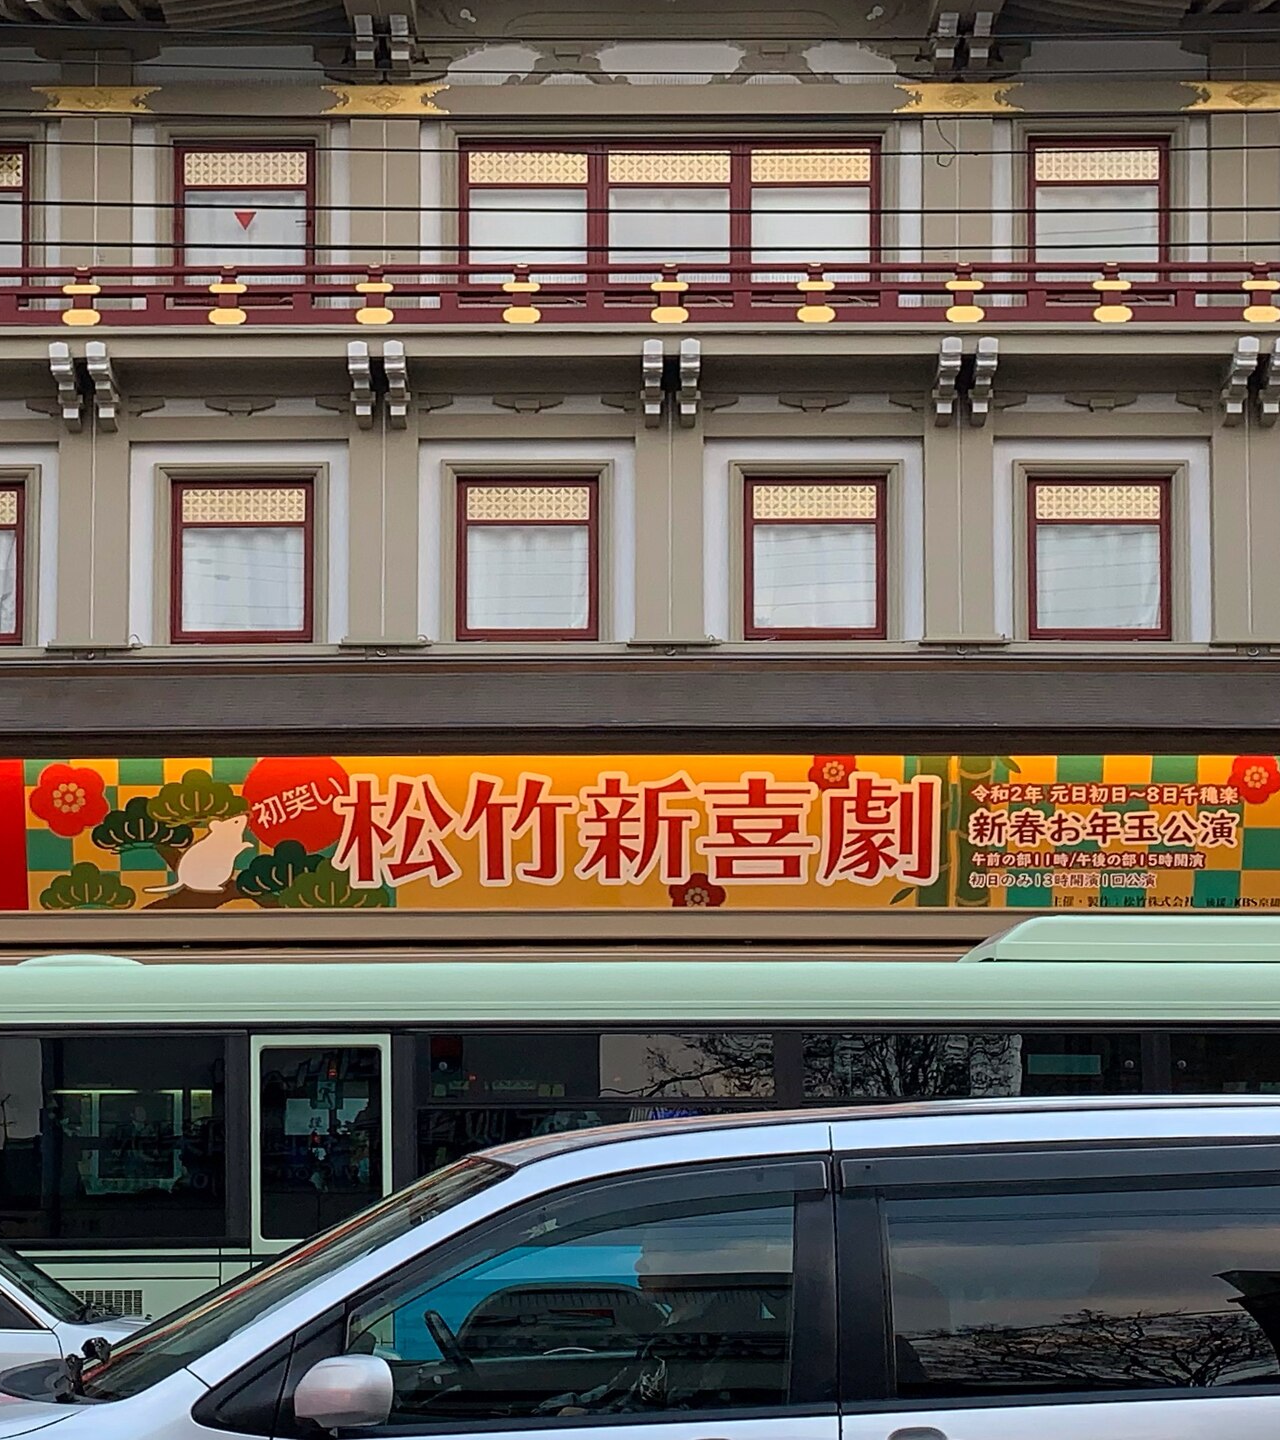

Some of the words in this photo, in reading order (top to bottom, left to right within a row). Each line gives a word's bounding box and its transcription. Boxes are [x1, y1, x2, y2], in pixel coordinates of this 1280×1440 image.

[252, 777, 345, 829] 初笑い
[971, 785, 1043, 804] 令和2年
[332, 772, 942, 887] 松竹新喜劇
[969, 809, 1238, 847] 新春お年玉公演
[969, 872, 1157, 888] 初日のみ13時開演1回公演
